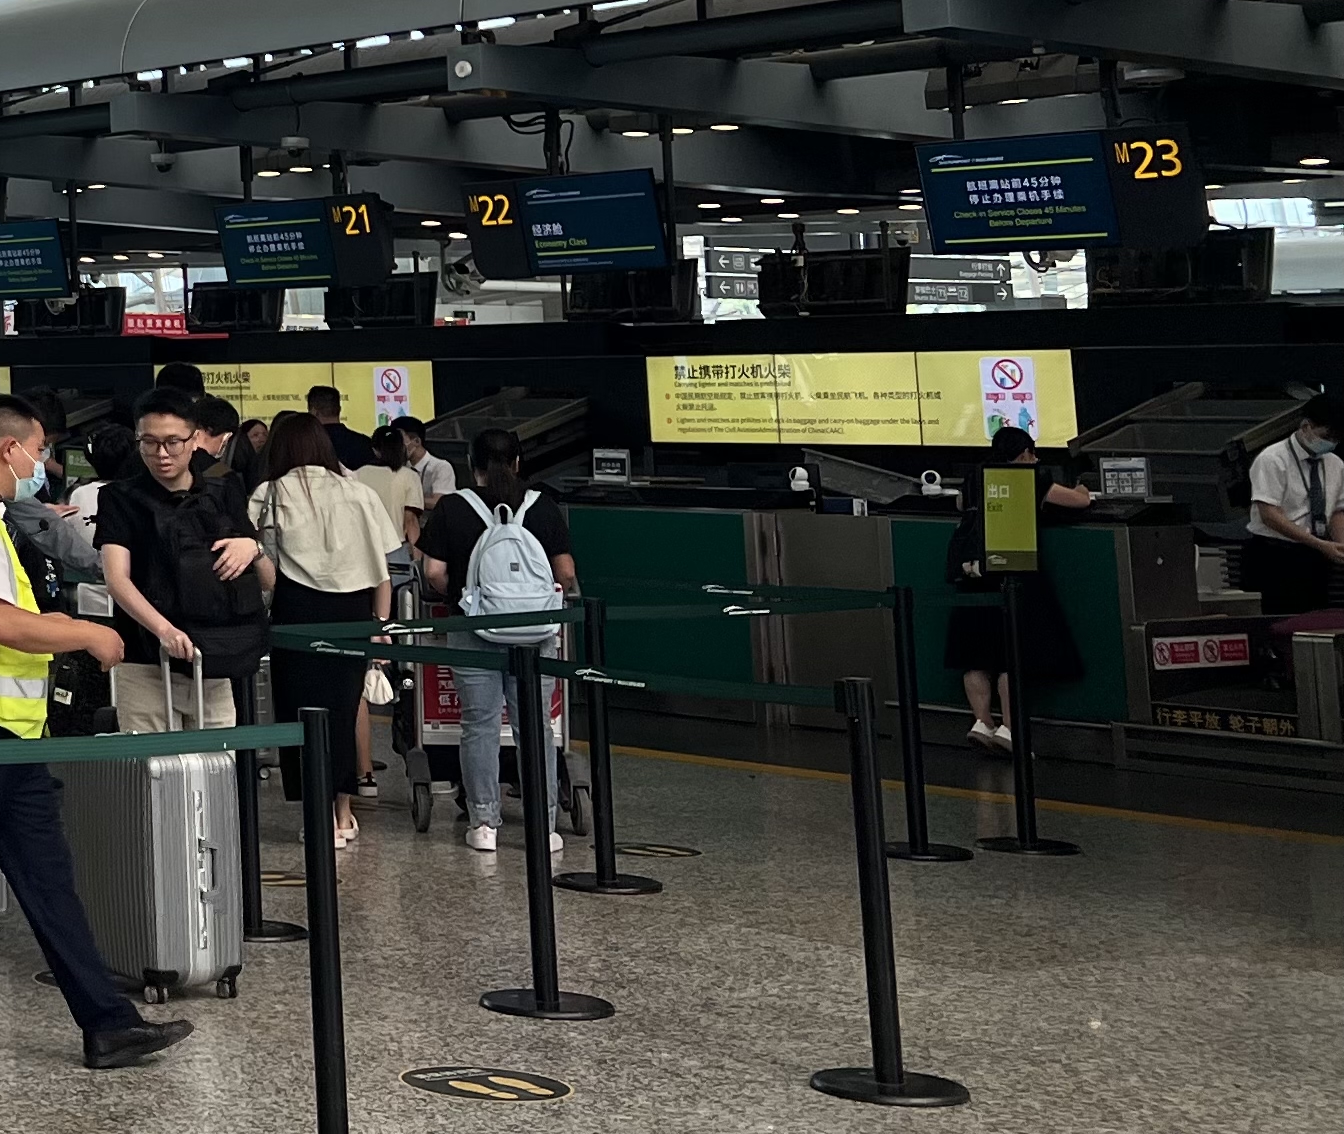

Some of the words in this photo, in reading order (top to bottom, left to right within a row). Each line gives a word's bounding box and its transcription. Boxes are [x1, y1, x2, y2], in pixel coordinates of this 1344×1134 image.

[532, 222, 564, 237] 经济舱
[534, 238, 567, 249] Economy
[568, 237, 588, 247] Class
[674, 364, 791, 380] 禁止携带打火机火柴
[987, 483, 1010, 499] 出口
[986, 502, 1003, 512] Exit
